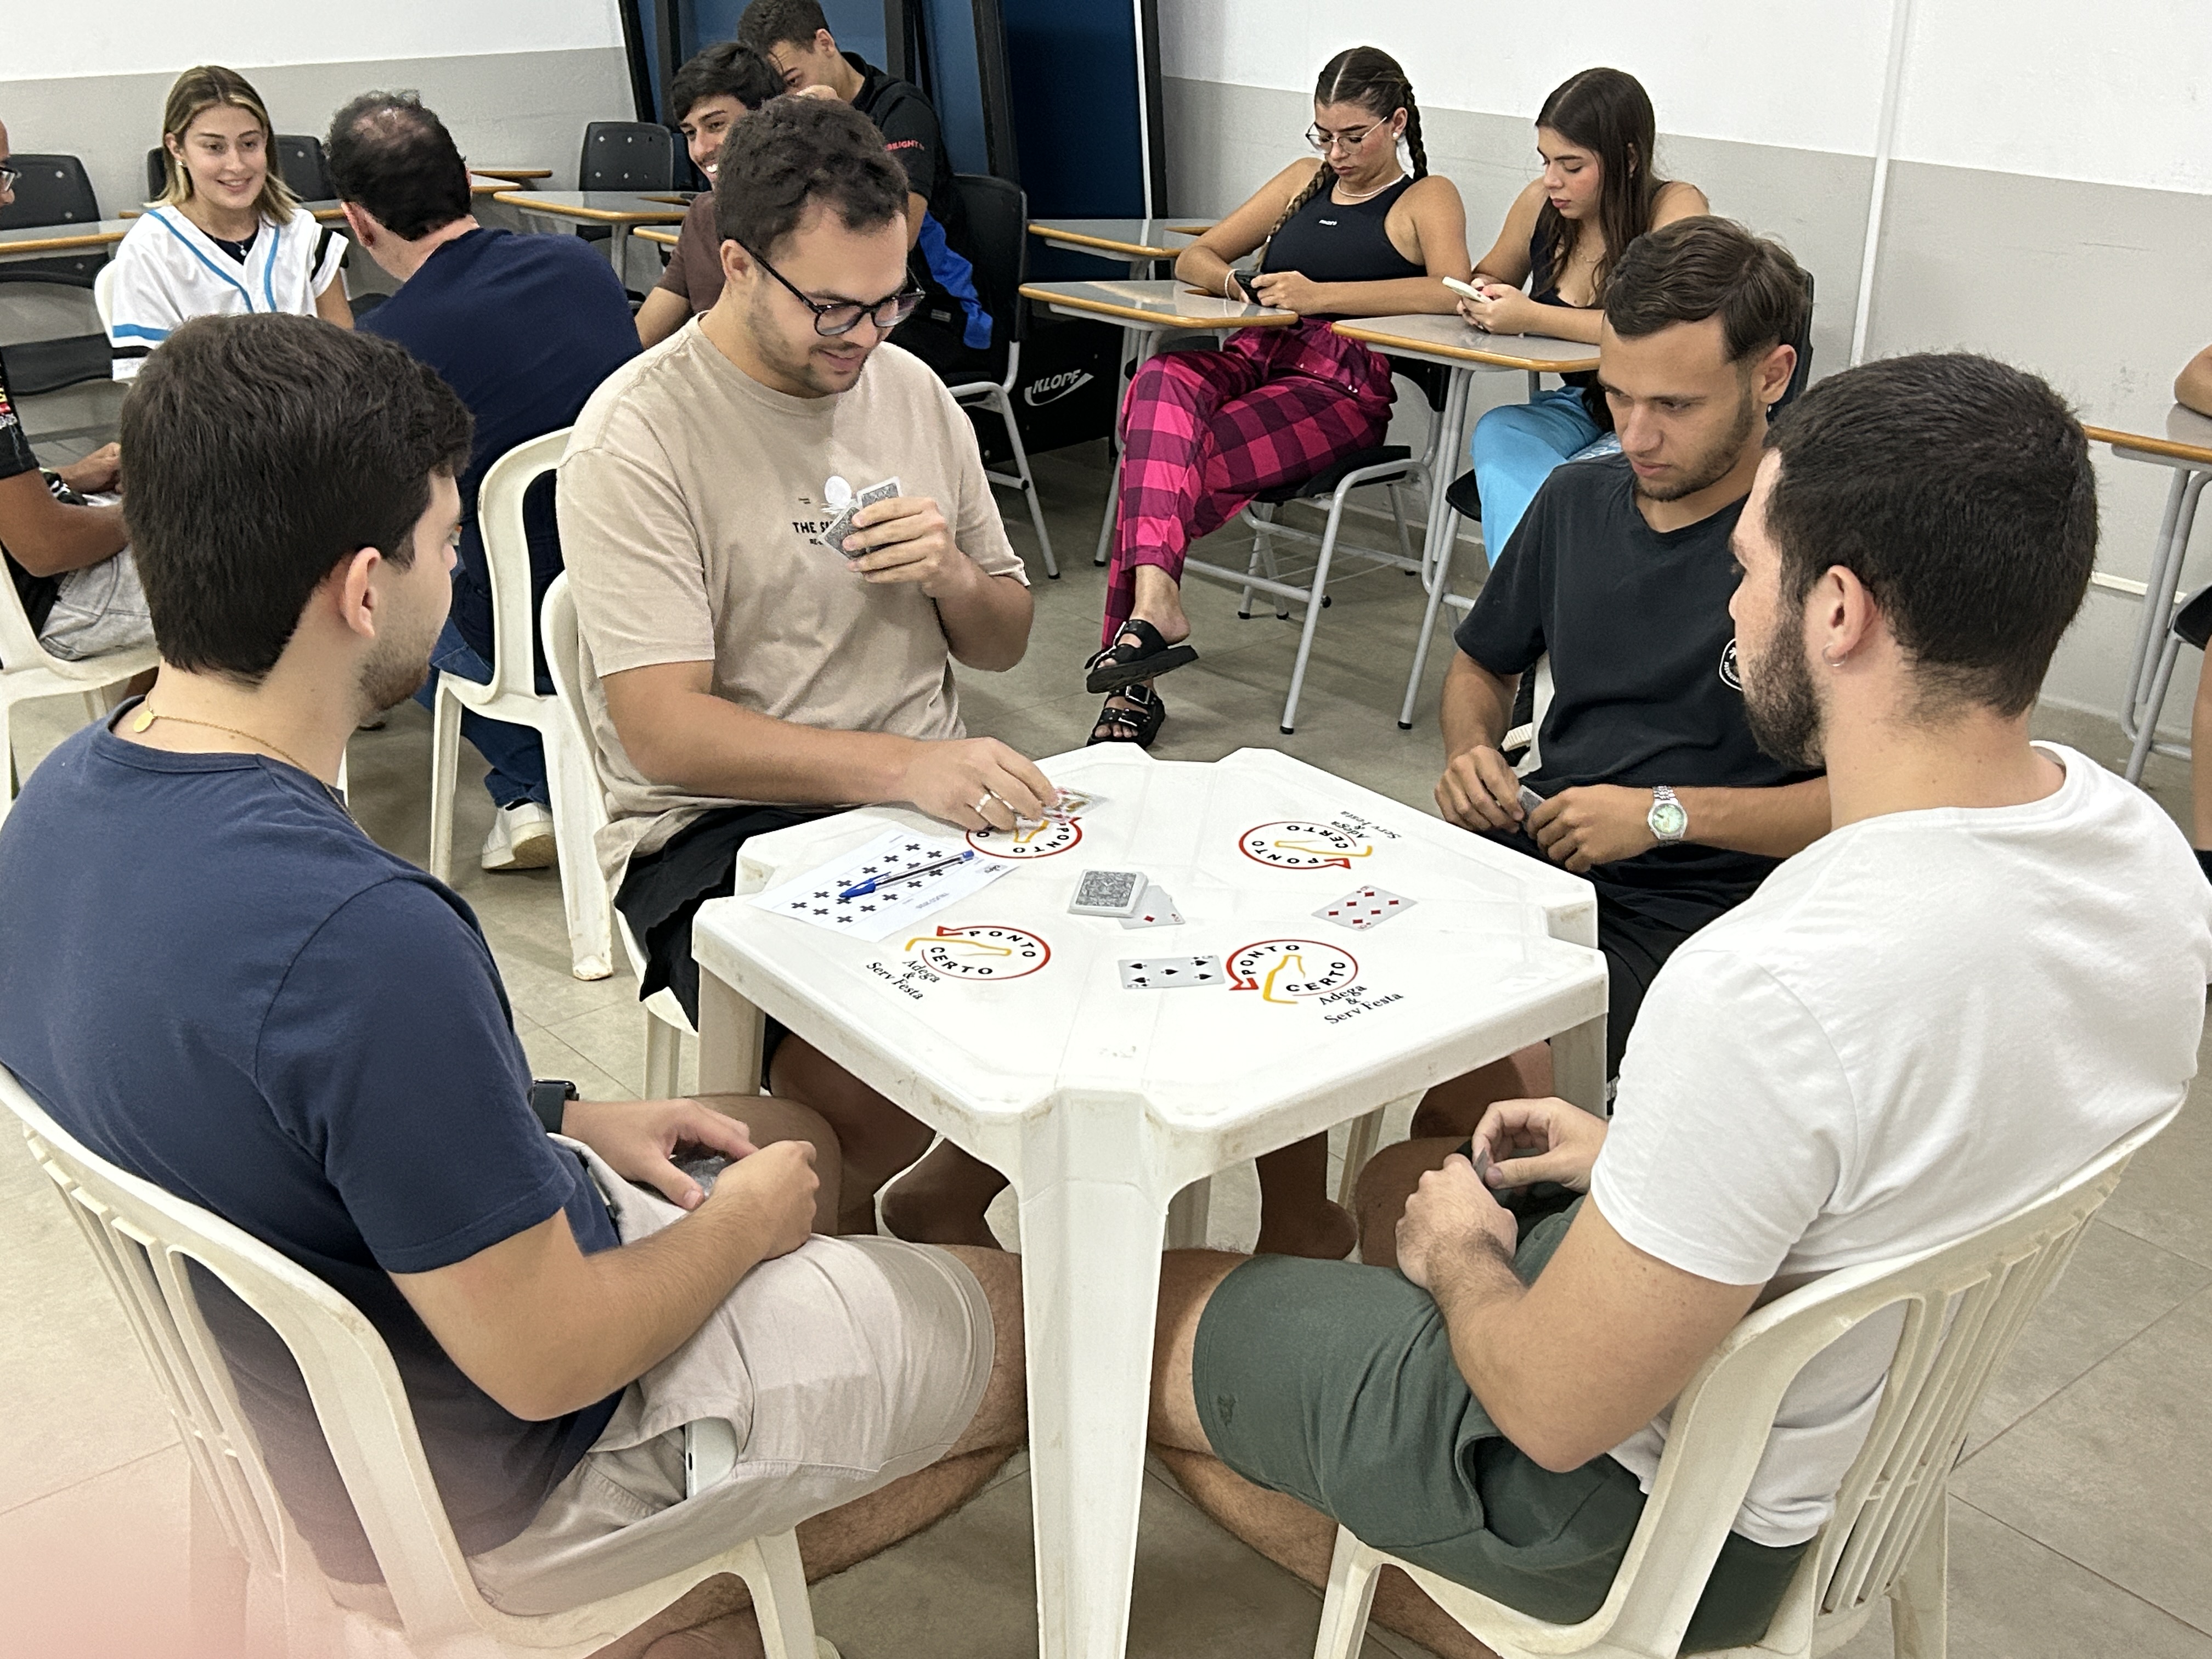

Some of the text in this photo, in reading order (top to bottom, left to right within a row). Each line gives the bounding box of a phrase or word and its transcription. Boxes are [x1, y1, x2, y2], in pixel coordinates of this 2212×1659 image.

[1032, 369, 1081, 394] KLOPF
[792, 521, 817, 534] THE
[1286, 825, 1349, 849] CERTO
[1251, 840, 1319, 864] PONTO
[968, 930, 1037, 957] PONTO
[902, 960, 941, 983] Adega
[930, 946, 994, 975] CERTO
[1239, 944, 1300, 975] PONTO
[865, 962, 924, 1001] Serv Festa
[1285, 962, 1347, 992] CERTO
[1318, 984, 1368, 1006] Adega
[1324, 992, 1405, 1025] Serv Festa
